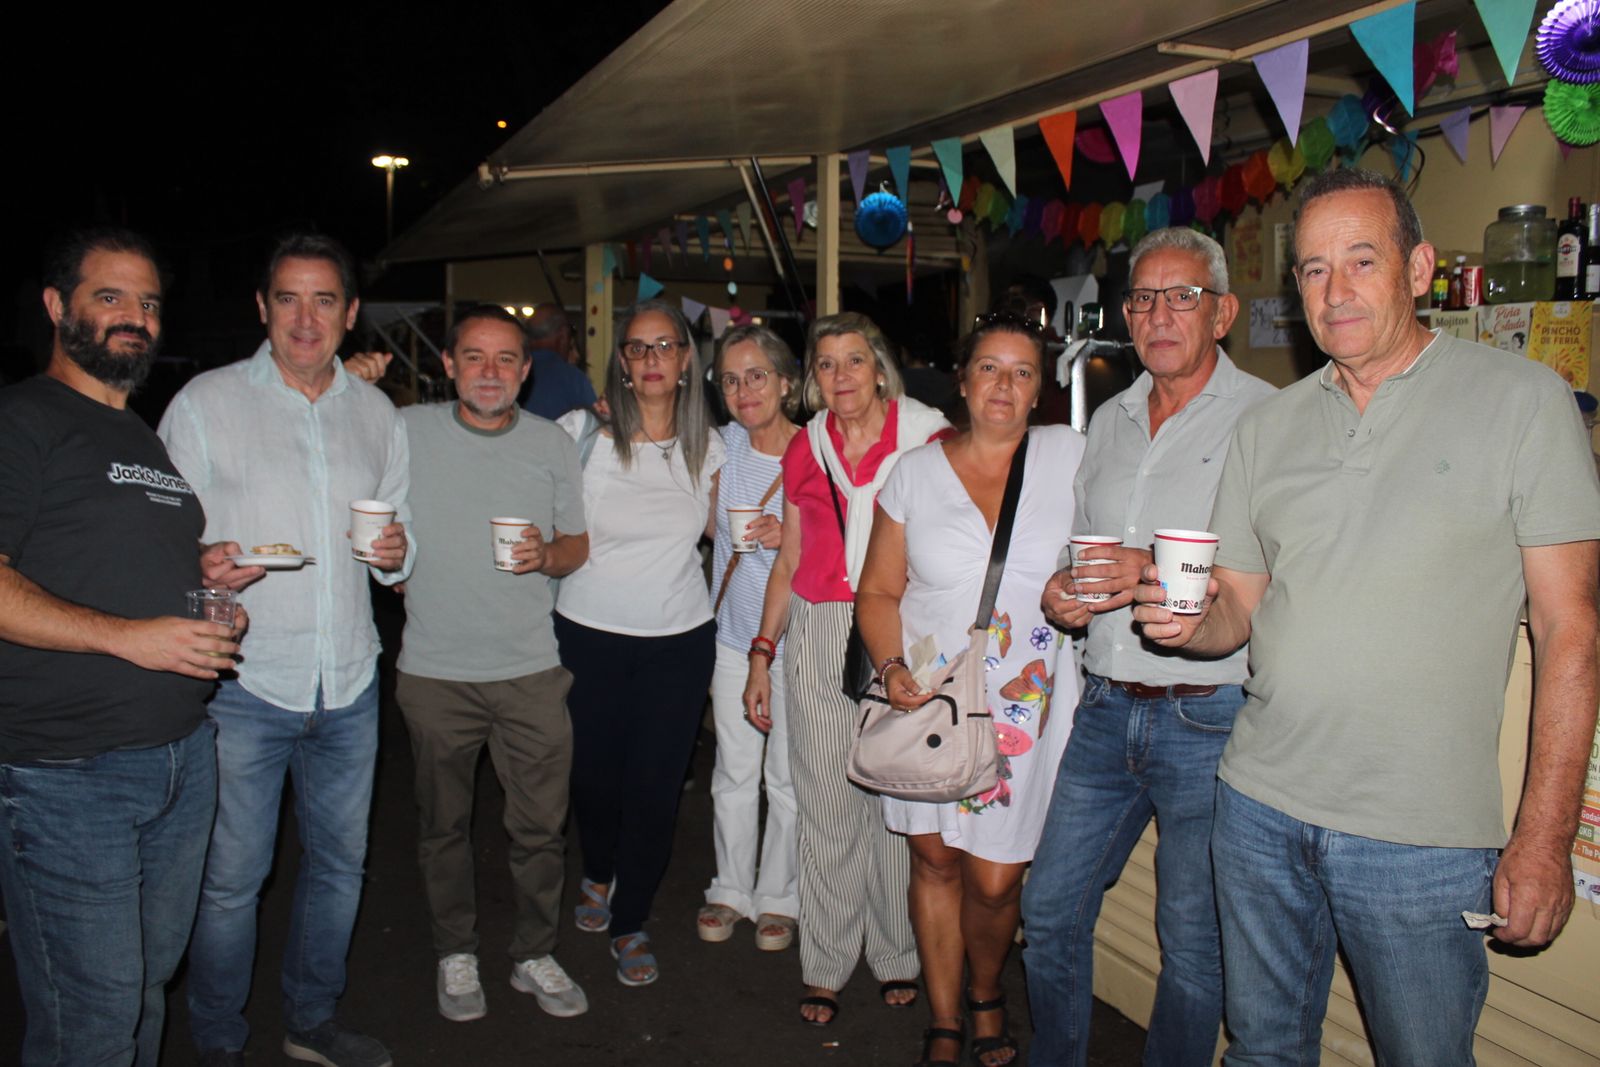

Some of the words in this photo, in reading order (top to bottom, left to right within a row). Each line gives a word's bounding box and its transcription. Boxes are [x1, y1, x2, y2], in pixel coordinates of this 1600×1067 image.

[1436, 316, 1469, 328] Mojitos
[1494, 318, 1526, 333] Colada
[1553, 337, 1580, 345] FERIA
